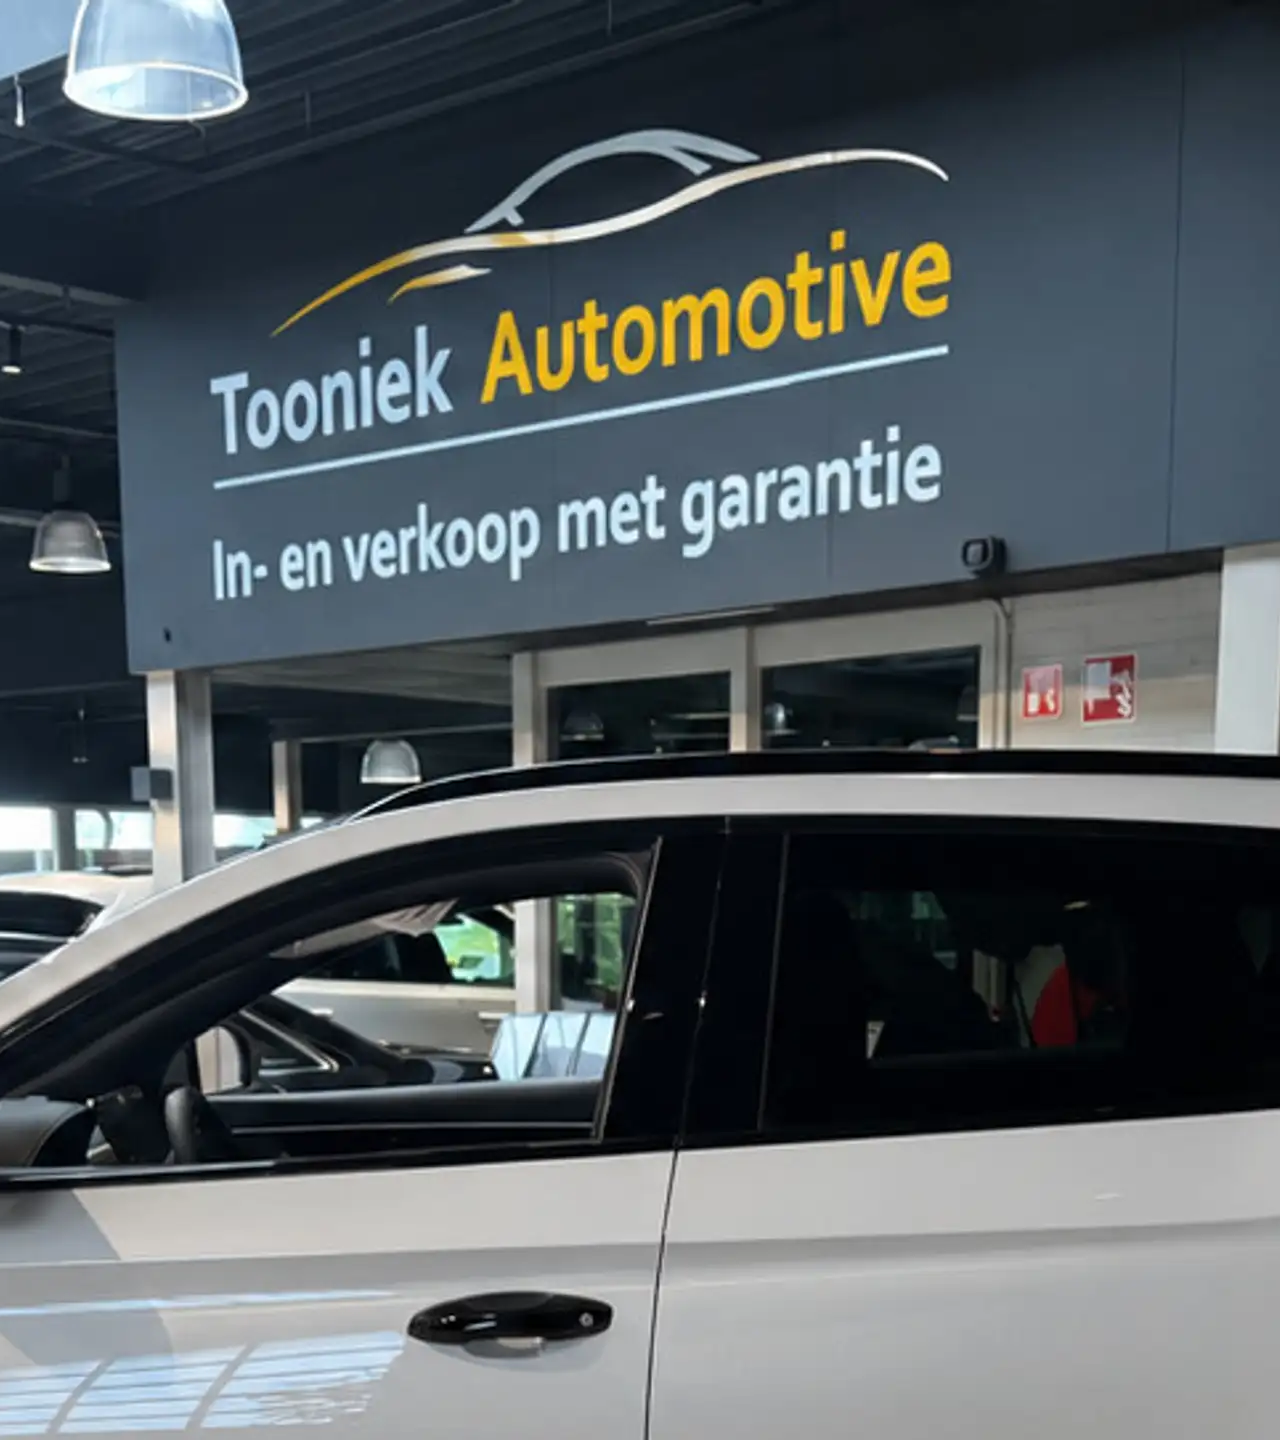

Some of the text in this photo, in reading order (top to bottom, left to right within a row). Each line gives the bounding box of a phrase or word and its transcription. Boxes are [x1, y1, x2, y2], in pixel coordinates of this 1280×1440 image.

[210, 229, 952, 456] Tooniek Automotive
[212, 424, 942, 601] In- en verkoop met garantie
